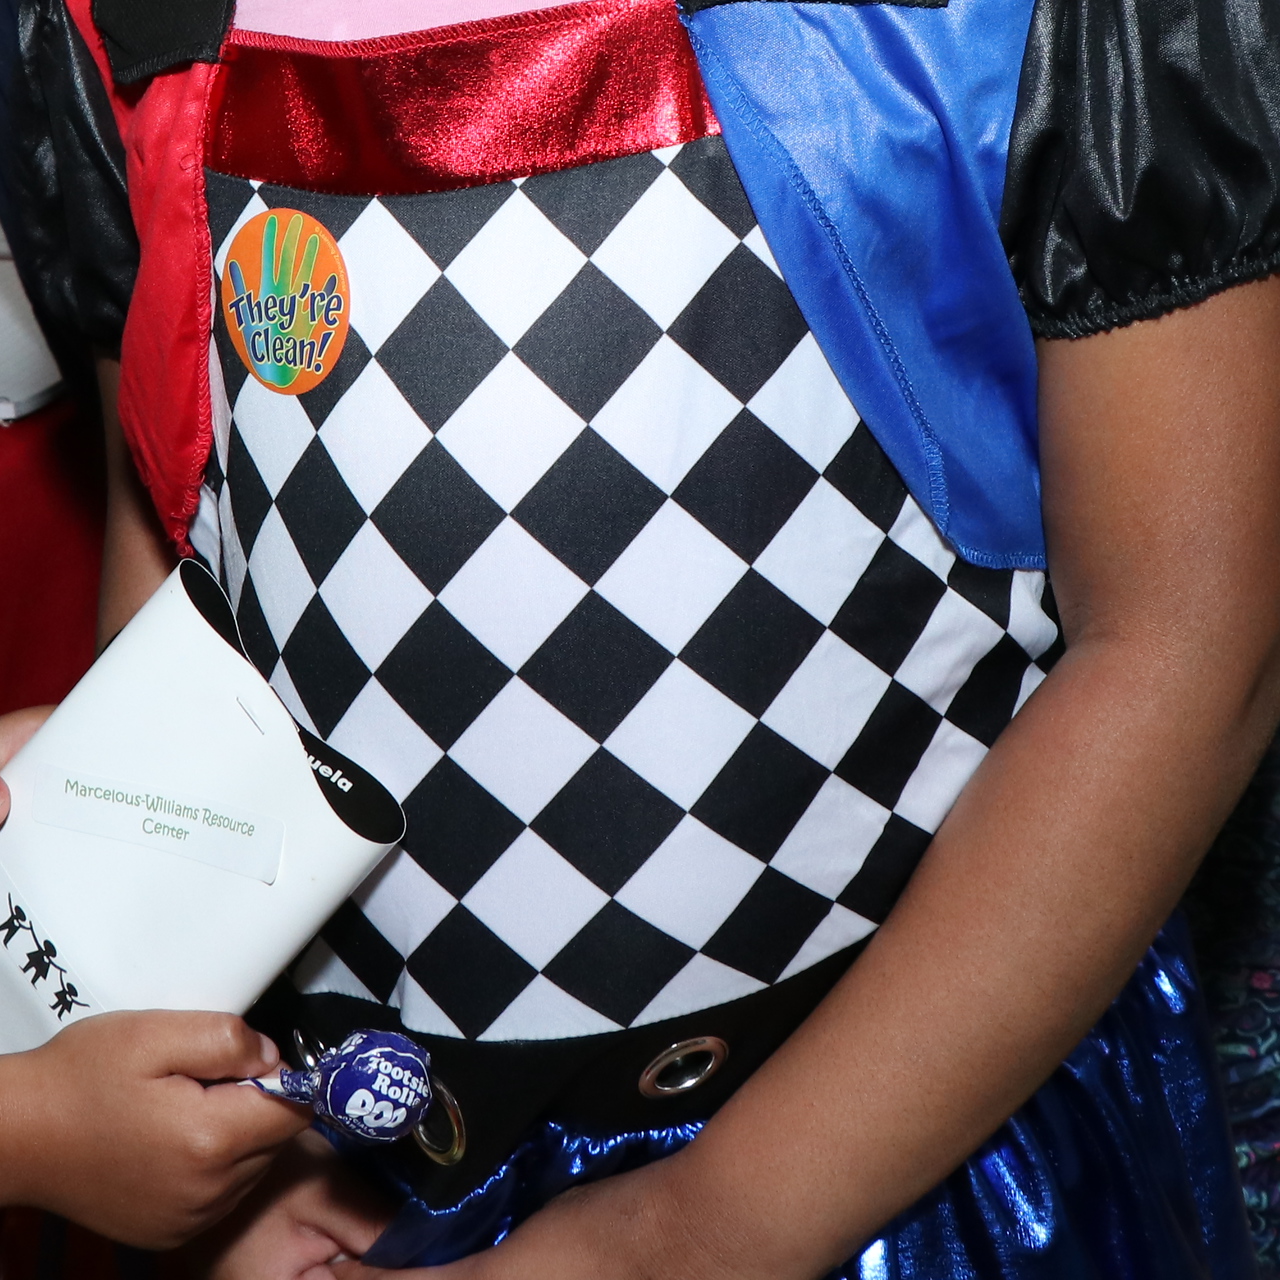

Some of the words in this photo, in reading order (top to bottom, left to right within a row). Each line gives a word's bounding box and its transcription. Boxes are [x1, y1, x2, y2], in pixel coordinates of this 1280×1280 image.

[228, 282, 343, 332] They're
[249, 327, 336, 374] Clean!
[63, 777, 200, 822] Marcelous-Williams
[202, 807, 256, 838] Resource
[141, 817, 191, 842] Center
[367, 1053, 430, 1099] Tootsie
